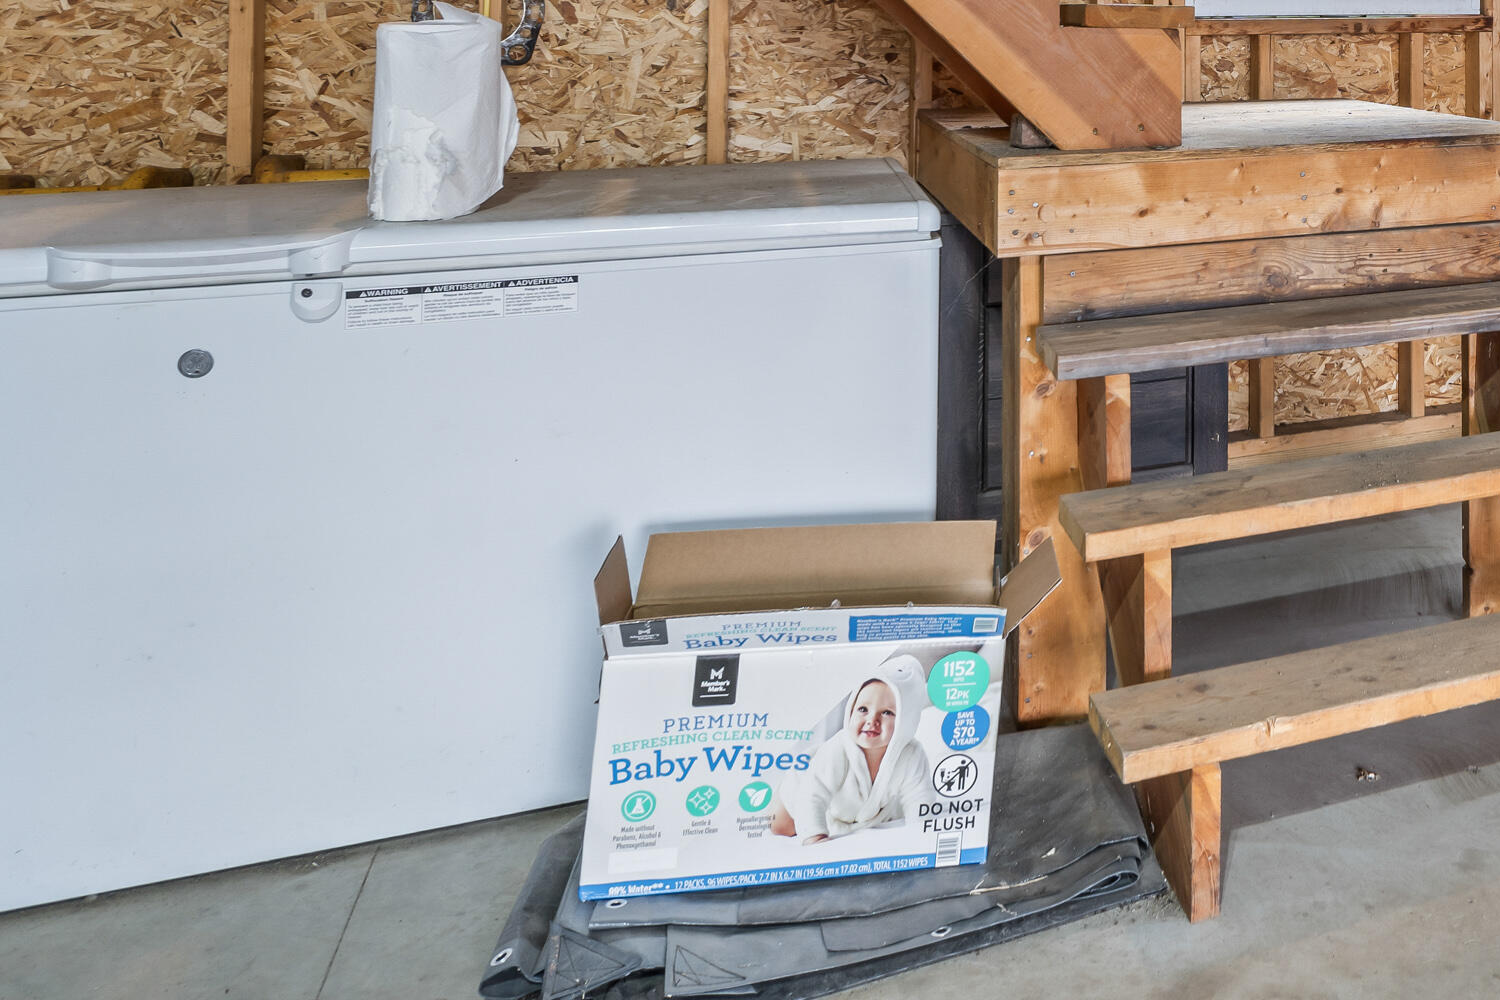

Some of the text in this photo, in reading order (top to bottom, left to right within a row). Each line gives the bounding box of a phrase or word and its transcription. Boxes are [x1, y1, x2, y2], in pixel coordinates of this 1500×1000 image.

[432, 281, 502, 292] AVERTISSEMENT
[516, 277, 574, 286] ADVERTENCIA
[367, 288, 409, 297] WARNING
[722, 620, 802, 630] PREMIUM
[683, 632, 838, 649] Baby Wipes
[943, 660, 975, 677] 1152
[663, 712, 769, 734] PREMIUM
[955, 718, 975, 727] UP TO
[957, 711, 975, 719] SAVE
[953, 726, 975, 738] $70
[612, 729, 814, 755] REFRESHING CLEAN SCENT
[608, 745, 811, 786] Baby Wipes
[919, 798, 984, 817] DO NOT
[923, 815, 975, 833] FLUSH
[675, 881, 683, 890] 12
[803, 867, 824, 879] (19.56
[825, 867, 834, 876] cm
[841, 865, 857, 875] 17.02
[873, 861, 890, 871] TOTAL
[893, 859, 908, 869] 1152
[908, 857, 928, 868] WIPES
